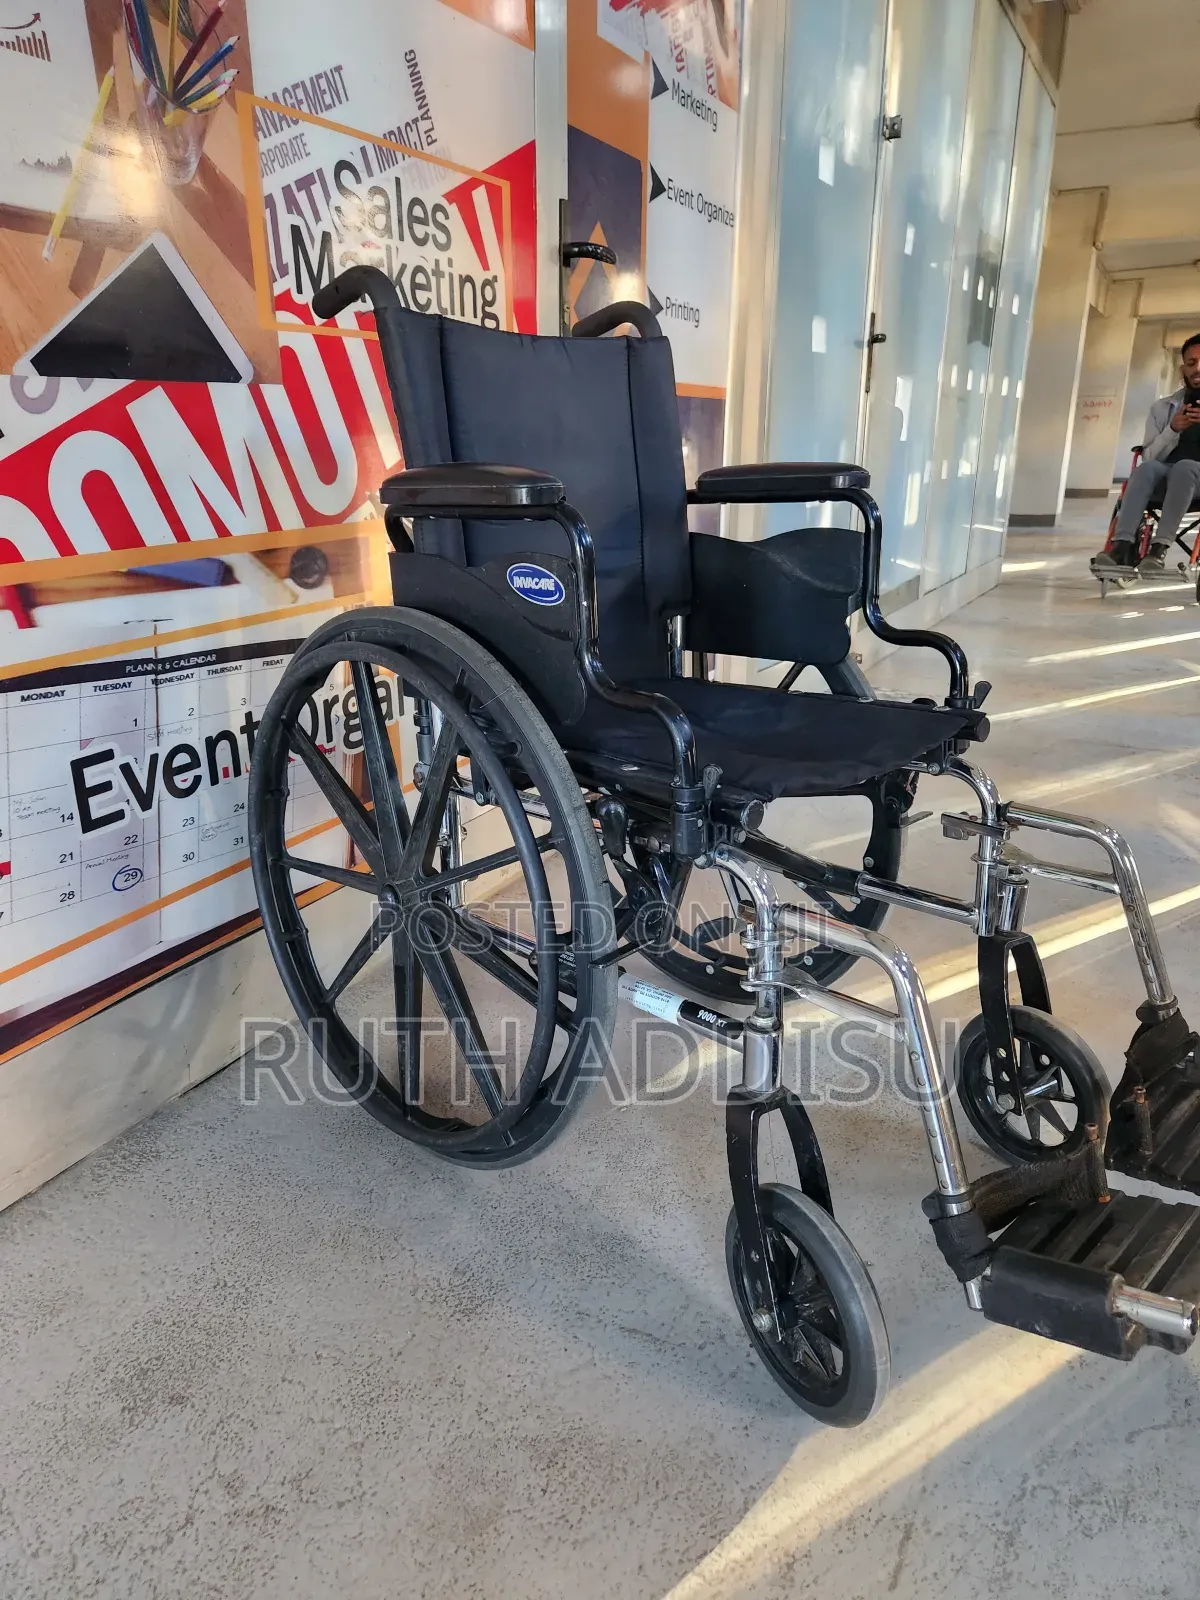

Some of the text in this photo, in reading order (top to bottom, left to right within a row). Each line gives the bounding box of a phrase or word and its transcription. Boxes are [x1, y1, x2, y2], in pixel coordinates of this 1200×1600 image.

[404, 49, 438, 147] PLANNING
[671, 78, 718, 133] Marketing
[372, 116, 425, 174] IMPACT
[334, 159, 452, 252] Sales
[667, 178, 734, 228] Event Organize
[665, 296, 700, 328] Printing
[513, 576, 556, 591] INVACARE
[165, 662, 170, 670] &
[173, 654, 217, 668] CALENDAR
[262, 658, 284, 668] FRIDAY
[207, 664, 243, 676] THURSDAY
[93, 681, 133, 692] TUESDAY
[329, 683, 335, 691] 5
[20, 689, 66, 702] MONDAY
[241, 697, 247, 706] 3
[188, 707, 194, 716] 2
[132, 718, 138, 727] 1
[70, 710, 260, 834] Event
[233, 802, 245, 813] 24
[60, 812, 74, 823] 14
[182, 816, 195, 827] 23
[123, 834, 139, 846] 22
[233, 836, 245, 846] 31
[59, 852, 74, 864] 21
[182, 852, 195, 862] 30
[123, 870, 139, 883] 29
[59, 890, 75, 902] 28
[697, 1008, 728, 1028] 9000 XT
